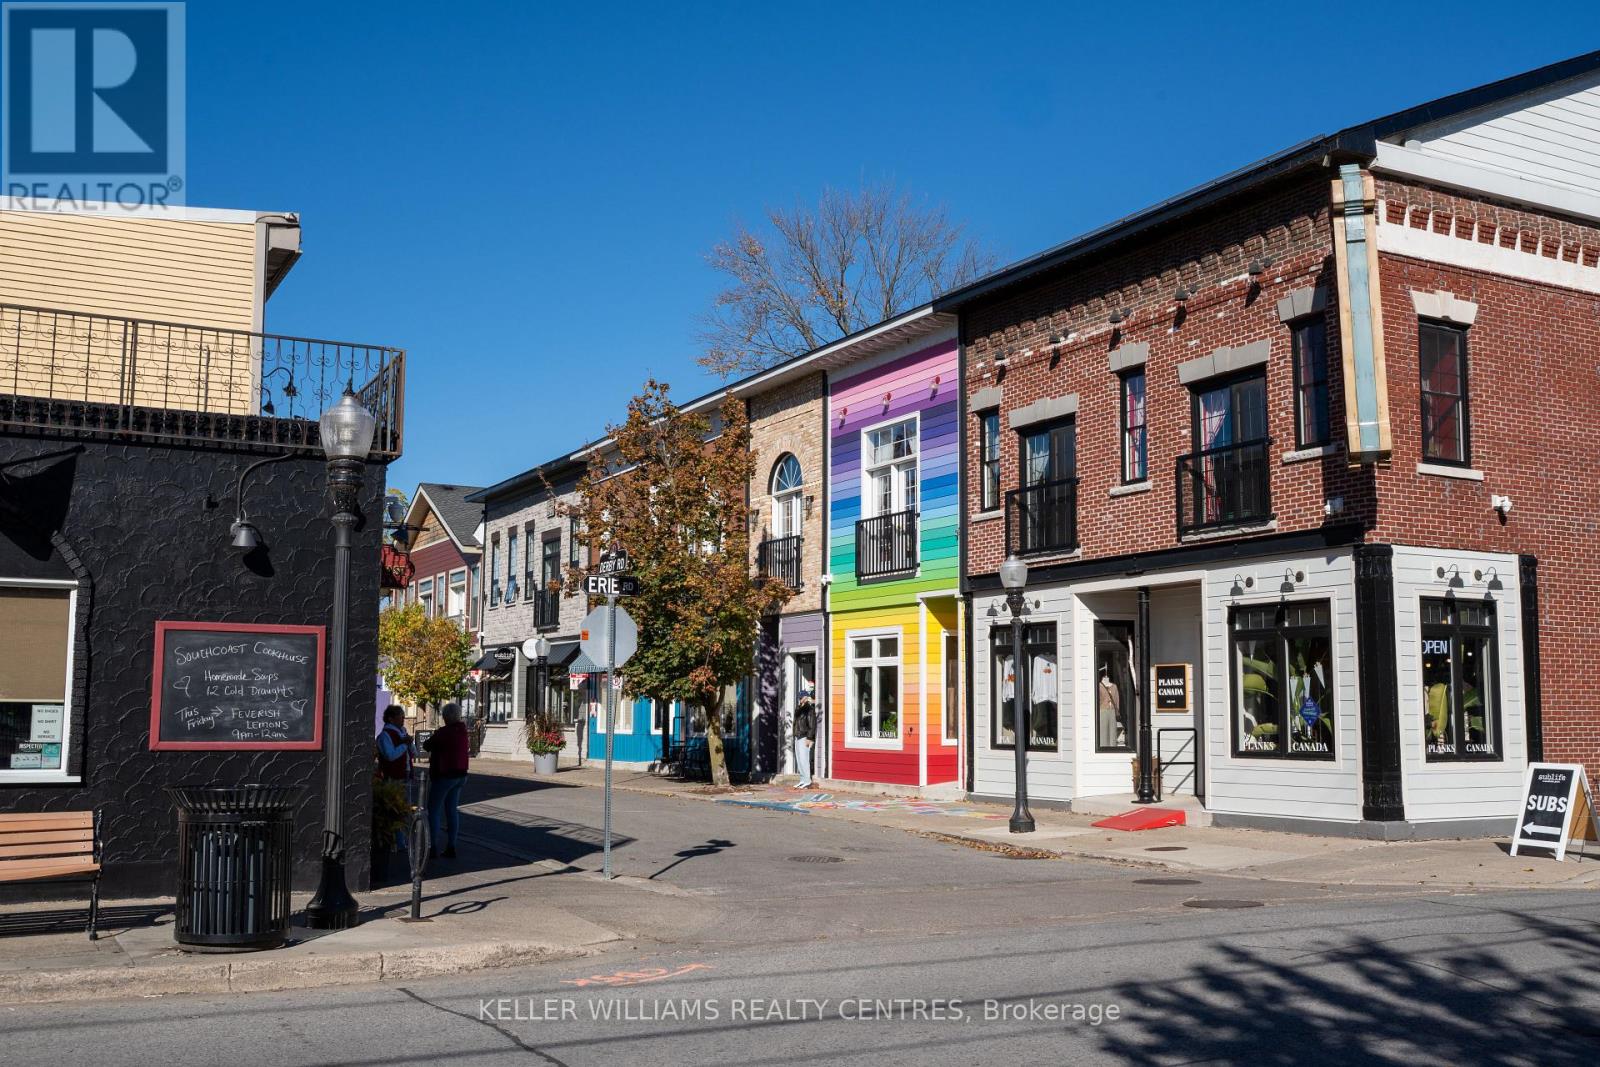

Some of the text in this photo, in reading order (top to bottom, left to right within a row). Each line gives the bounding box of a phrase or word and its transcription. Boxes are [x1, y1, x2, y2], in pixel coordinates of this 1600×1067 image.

[600, 558, 624, 573] DERBY RD
[588, 576, 634, 594] ERIE RD
[252, 668, 279, 684] Soups
[1158, 678, 1184, 686] PLANKS
[207, 684, 295, 703] 12 Cold Draughts
[1158, 688, 1184, 696] CANADA
[174, 705, 200, 720] This
[187, 715, 215, 731] Friday
[1030, 737, 1055, 745] CANADA
[1243, 741, 1328, 752] PLANKS CANADA
[1428, 743, 1494, 753] PLANKS CANADA
[1538, 773, 1566, 781] sublife
[1527, 794, 1568, 813] SUBS
